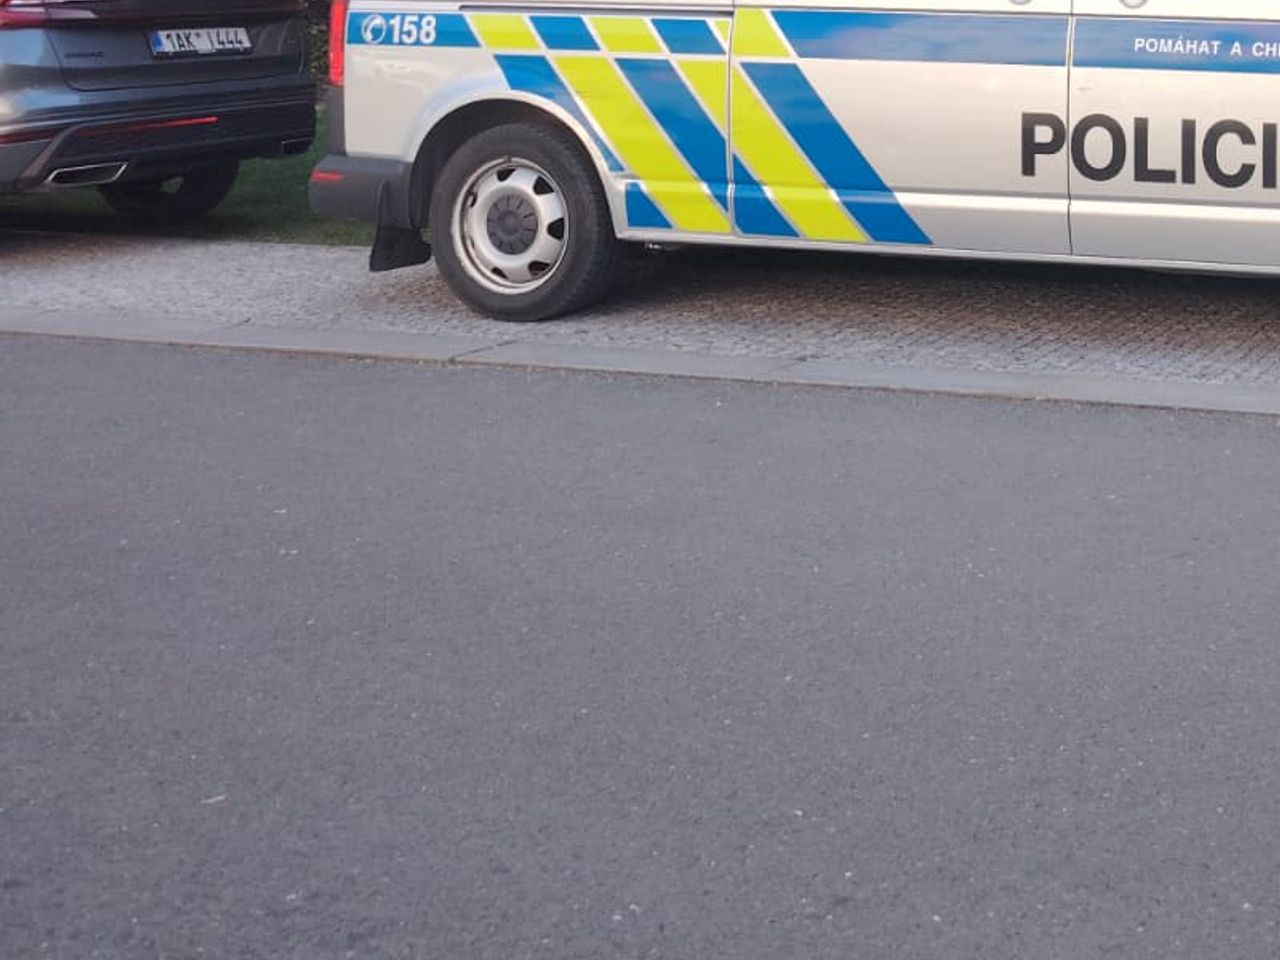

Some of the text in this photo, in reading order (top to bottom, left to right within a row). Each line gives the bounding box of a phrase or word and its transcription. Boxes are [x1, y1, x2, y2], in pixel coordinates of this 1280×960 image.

[389, 15, 436, 45] 158
[1134, 36, 1221, 55] POMÁHAT
[1230, 41, 1242, 56] A
